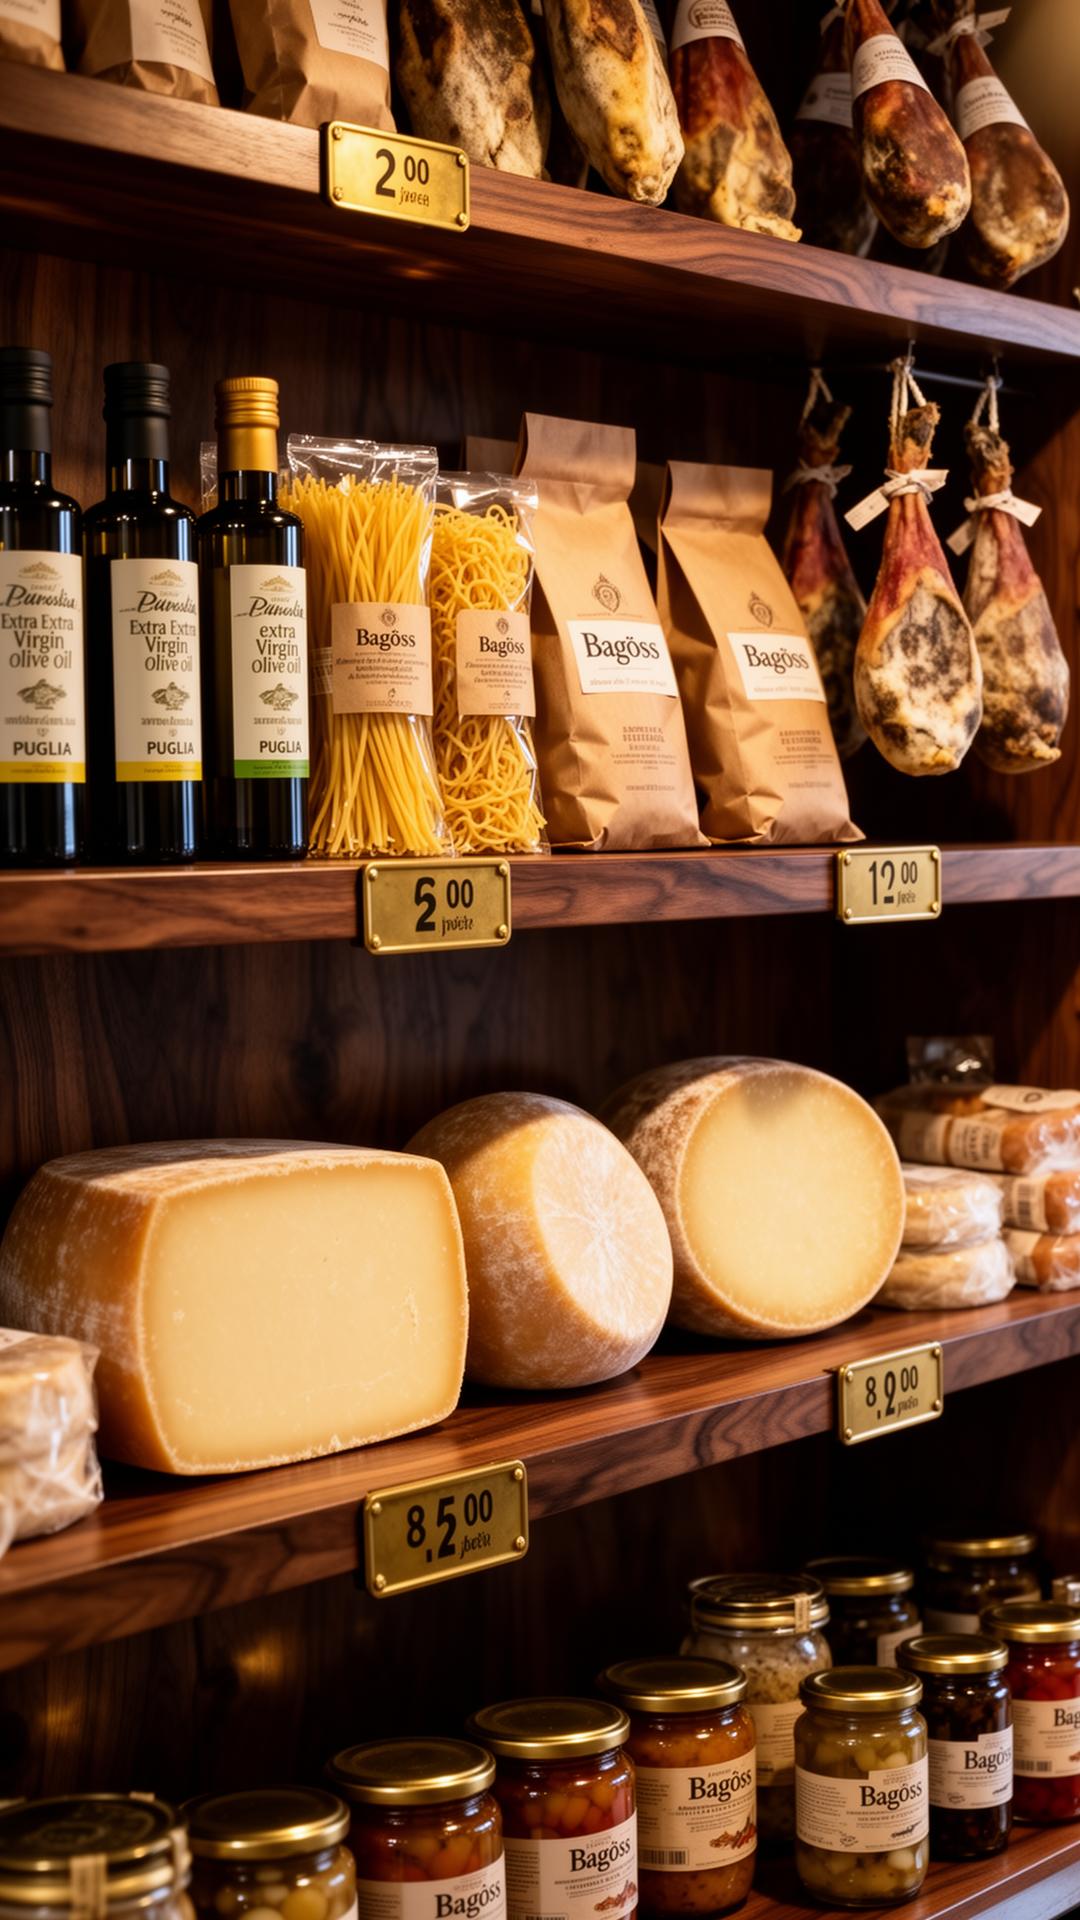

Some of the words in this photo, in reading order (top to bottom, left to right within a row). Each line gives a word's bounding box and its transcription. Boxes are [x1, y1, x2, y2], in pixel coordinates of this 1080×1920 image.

[1, 613, 38, 629] Extra
[41, 614, 74, 630] Extra
[130, 620, 166, 635] Extra
[170, 620, 196, 636] Extra
[260, 624, 296, 638] extra
[14, 630, 64, 654] Virgin
[145, 636, 188, 658] Virgin
[256, 639, 299, 660] Virgin
[581, 632, 660, 666] Bagöss
[54, 650, 72, 669] oil
[180, 655, 193, 672] oil
[287, 657, 301, 674] oil
[742, 644, 810, 674] Bagöss
[13, 741, 72, 756] PUGLIA
[147, 741, 194, 755] PUGLIA
[260, 740, 302, 754] PUGLIA
